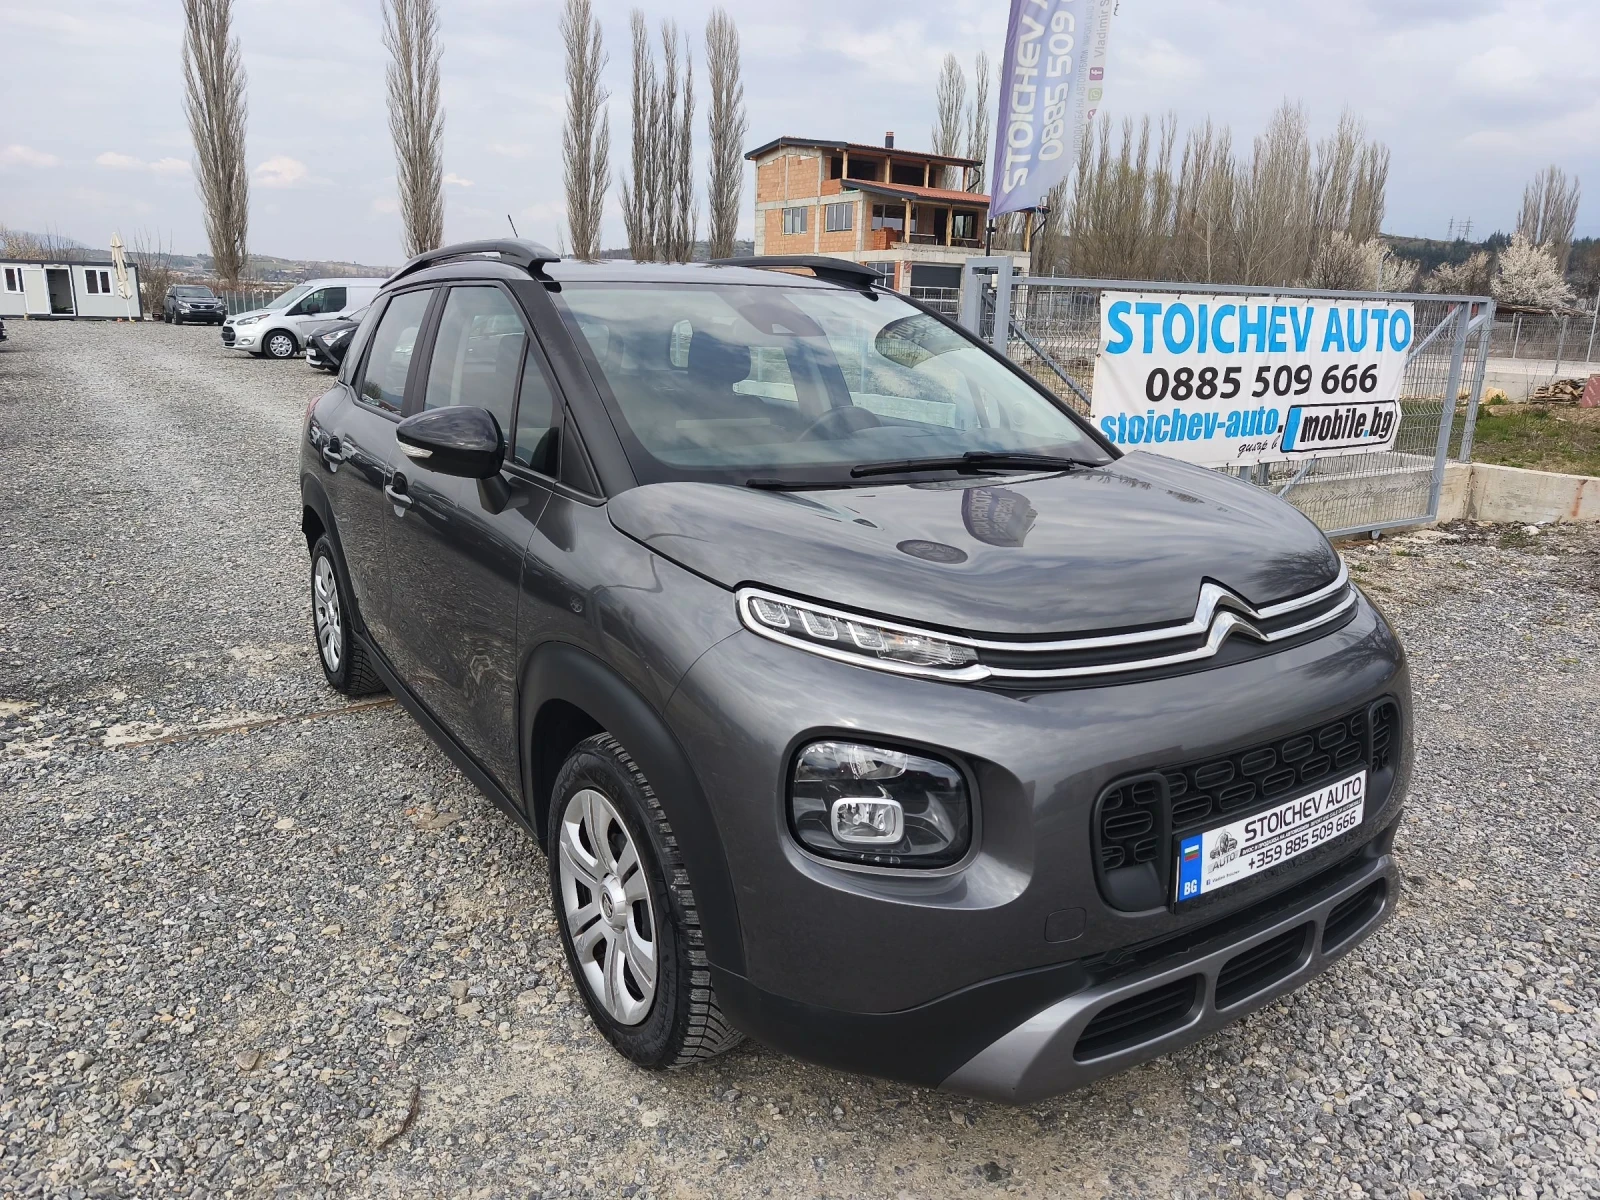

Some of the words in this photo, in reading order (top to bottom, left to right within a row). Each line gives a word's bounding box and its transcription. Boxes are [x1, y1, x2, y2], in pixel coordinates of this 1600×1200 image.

[1046, 10, 1075, 78] 509
[1094, 10, 1108, 58] Vladimir
[1002, 14, 1045, 194] STOICHEV
[1038, 81, 1069, 161] 0885
[1105, 300, 1314, 354] STOICHEV
[1321, 308, 1411, 352] AUTO
[1145, 366, 1242, 402] 0885
[1251, 364, 1312, 397] 509
[1321, 363, 1378, 394] 666
[1300, 406, 1394, 442] mobile.bg
[1244, 793, 1323, 842] STOICHEV
[1325, 777, 1362, 809] AUTO
[1212, 852, 1236, 871] AUTO
[1248, 845, 1282, 869] +359
[1285, 832, 1309, 856] 885
[1311, 821, 1334, 845] 509
[1336, 810, 1356, 832] 666
[1184, 879, 1198, 896] BG
